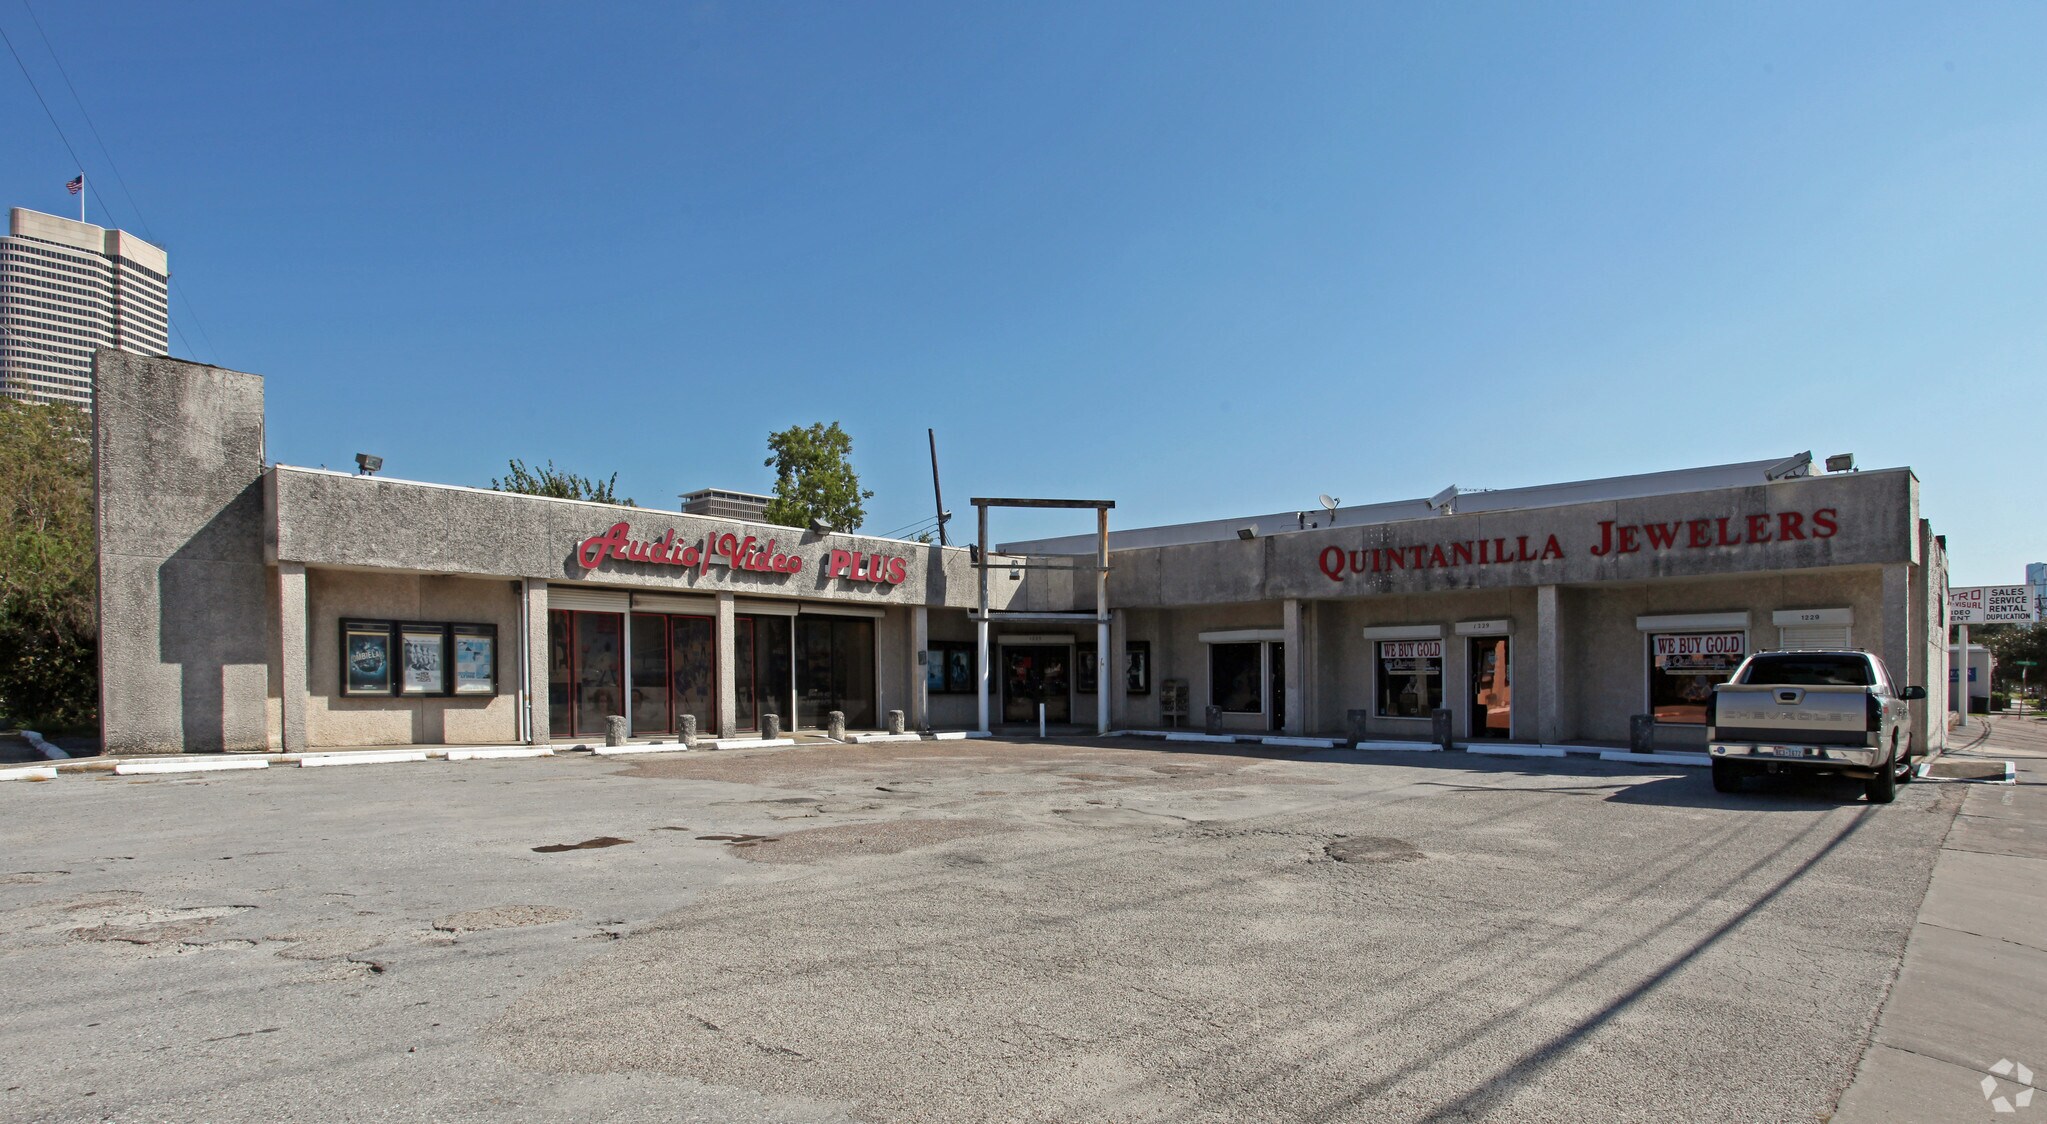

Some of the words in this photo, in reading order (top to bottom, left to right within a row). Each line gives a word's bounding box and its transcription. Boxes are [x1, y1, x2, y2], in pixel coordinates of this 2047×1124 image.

[1318, 533, 1565, 582] QUINTANILLA
[1590, 508, 1840, 557] JEWELERS
[826, 549, 908, 585] PLUS
[1991, 588, 2024, 596] SALES
[1989, 596, 2027, 605] SERVICE
[1989, 605, 2026, 613] RENTAL
[1384, 643, 1396, 657] WE
[1399, 642, 1415, 657] BUY
[1417, 642, 1440, 657] GOLD
[1658, 637, 1675, 654] WE
[1679, 636, 1702, 654] BUY
[1706, 636, 1740, 653] GOLD
[1724, 710, 1859, 722] CHEVROLET
